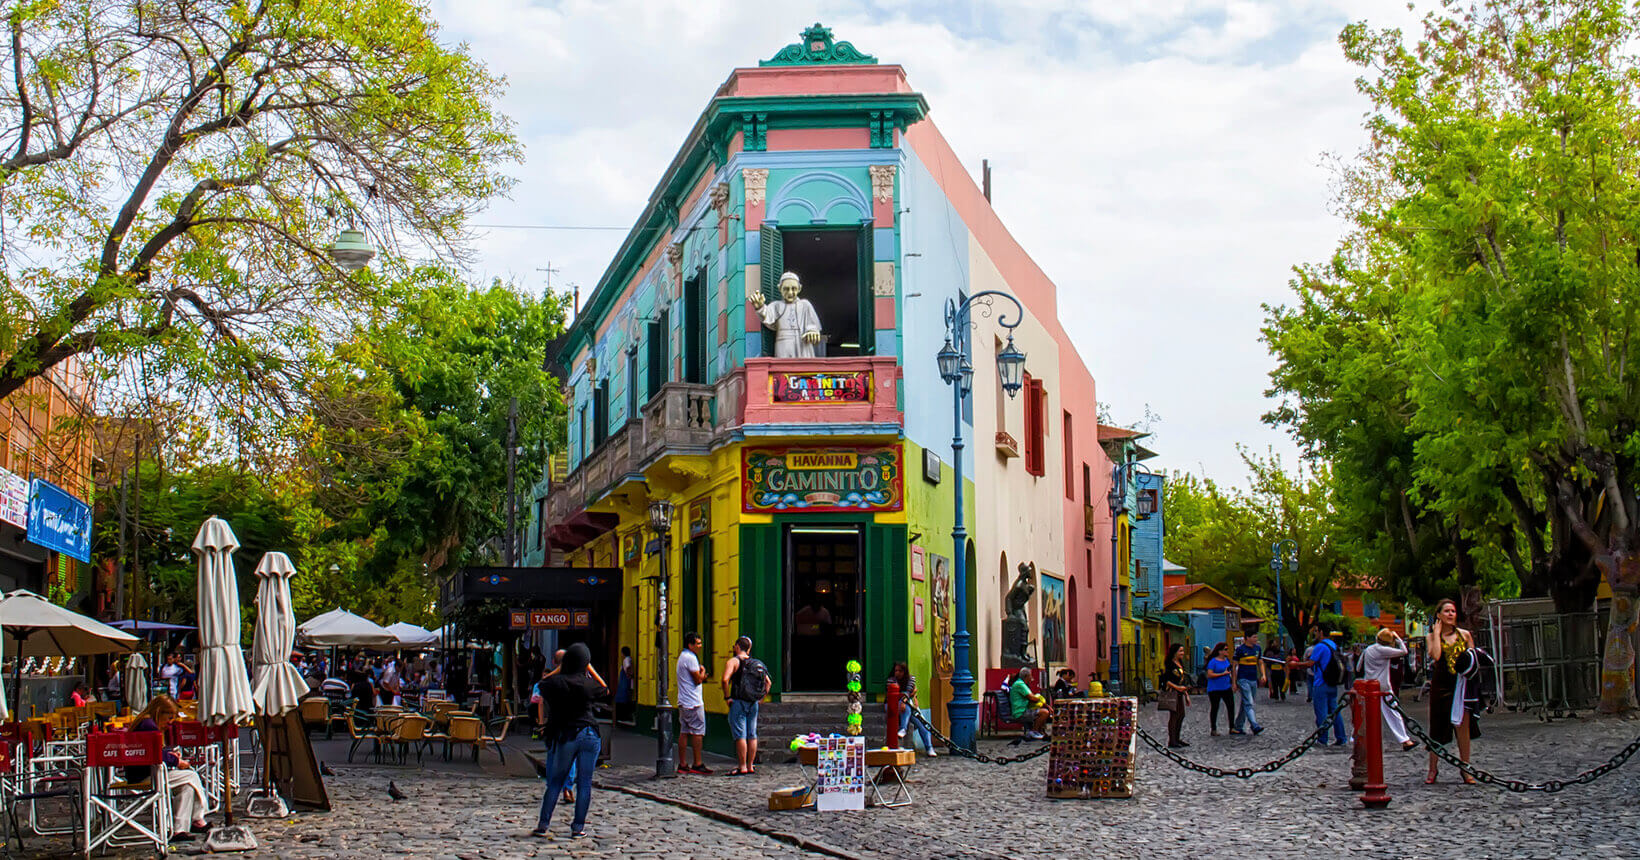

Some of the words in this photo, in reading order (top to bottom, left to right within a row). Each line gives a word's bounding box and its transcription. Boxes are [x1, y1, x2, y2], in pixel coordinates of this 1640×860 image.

[793, 455, 852, 467] HAVANNA
[767, 467, 879, 491] CAMINITO
[534, 614, 567, 624] TANGO
